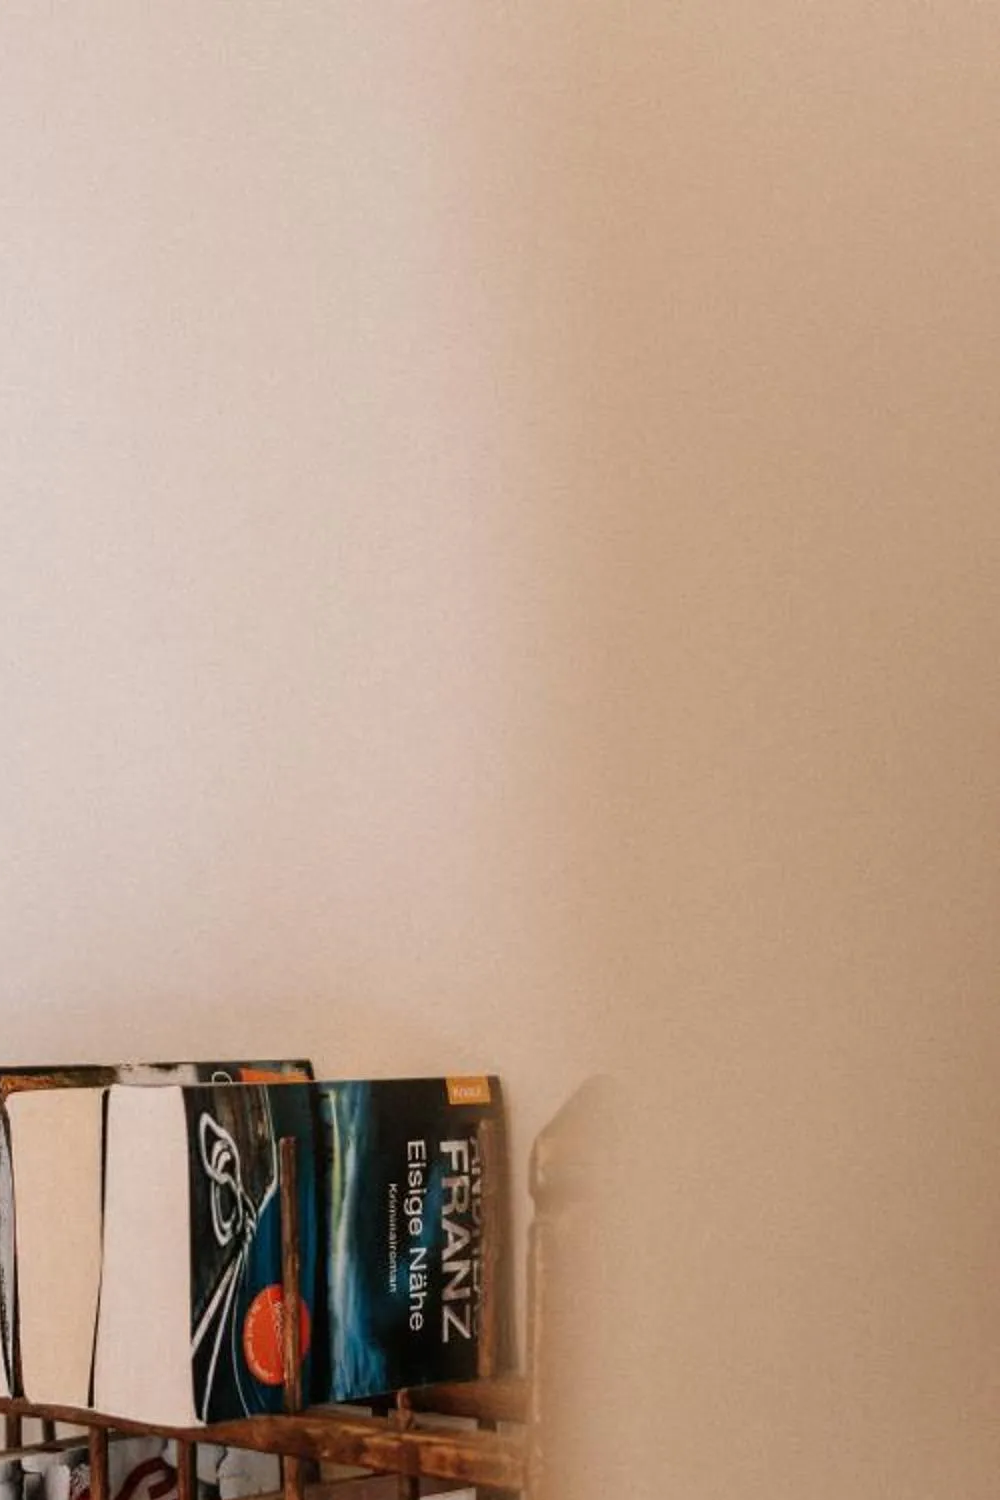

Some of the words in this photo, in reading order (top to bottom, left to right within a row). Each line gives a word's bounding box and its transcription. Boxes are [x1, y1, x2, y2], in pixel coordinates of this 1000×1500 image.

[388, 1183, 398, 1294] Kriminalroman
[403, 1140, 425, 1236] Eisige
[407, 1248, 427, 1332] Nähe
[439, 1139, 472, 1344] FRANZ
